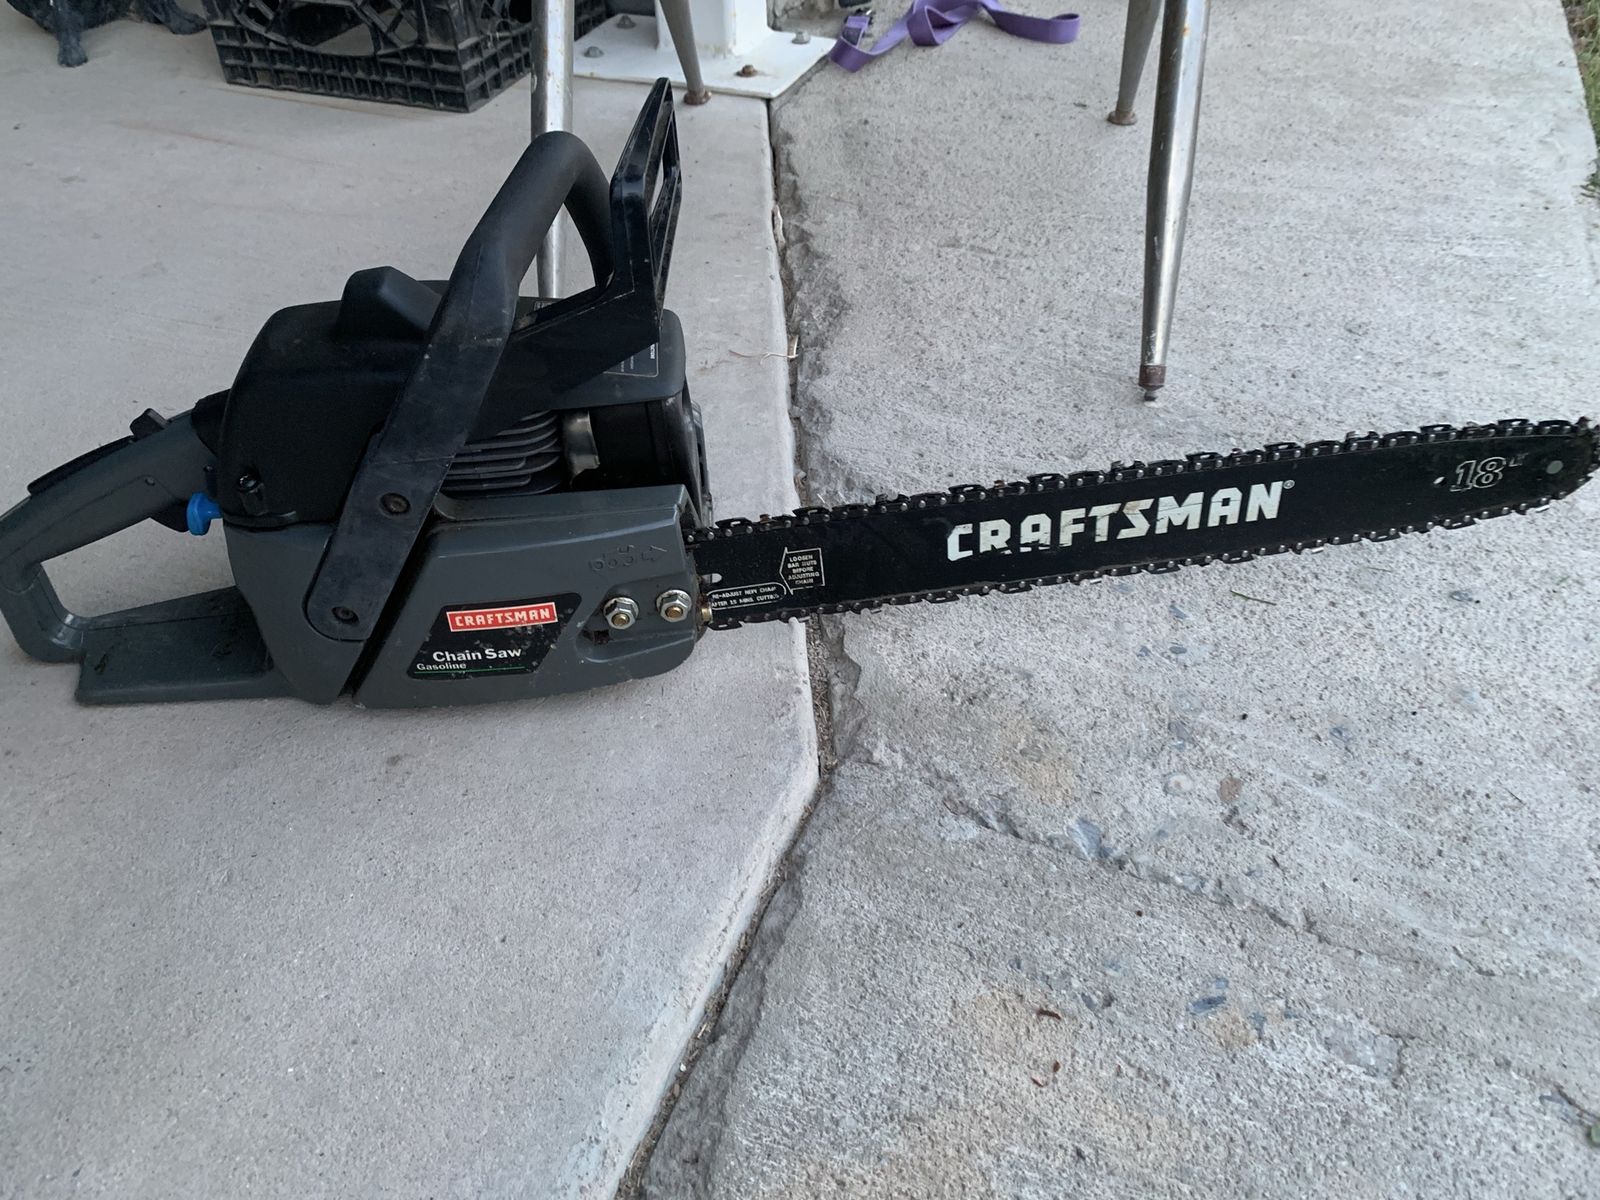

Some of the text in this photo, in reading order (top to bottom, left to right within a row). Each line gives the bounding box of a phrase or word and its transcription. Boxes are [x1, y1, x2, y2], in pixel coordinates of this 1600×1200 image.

[1450, 456, 1507, 492] 18
[947, 480, 1284, 562] CRAFTSMAN
[789, 554, 814, 562] LOOSEN
[792, 566, 814, 574] BEFORE
[788, 571, 820, 580] ADJUSTING
[711, 600, 728, 608] AFTER
[454, 607, 551, 627] CRAFTSMAN
[432, 648, 522, 663] Chain Saw
[416, 662, 467, 672] Gasoline
